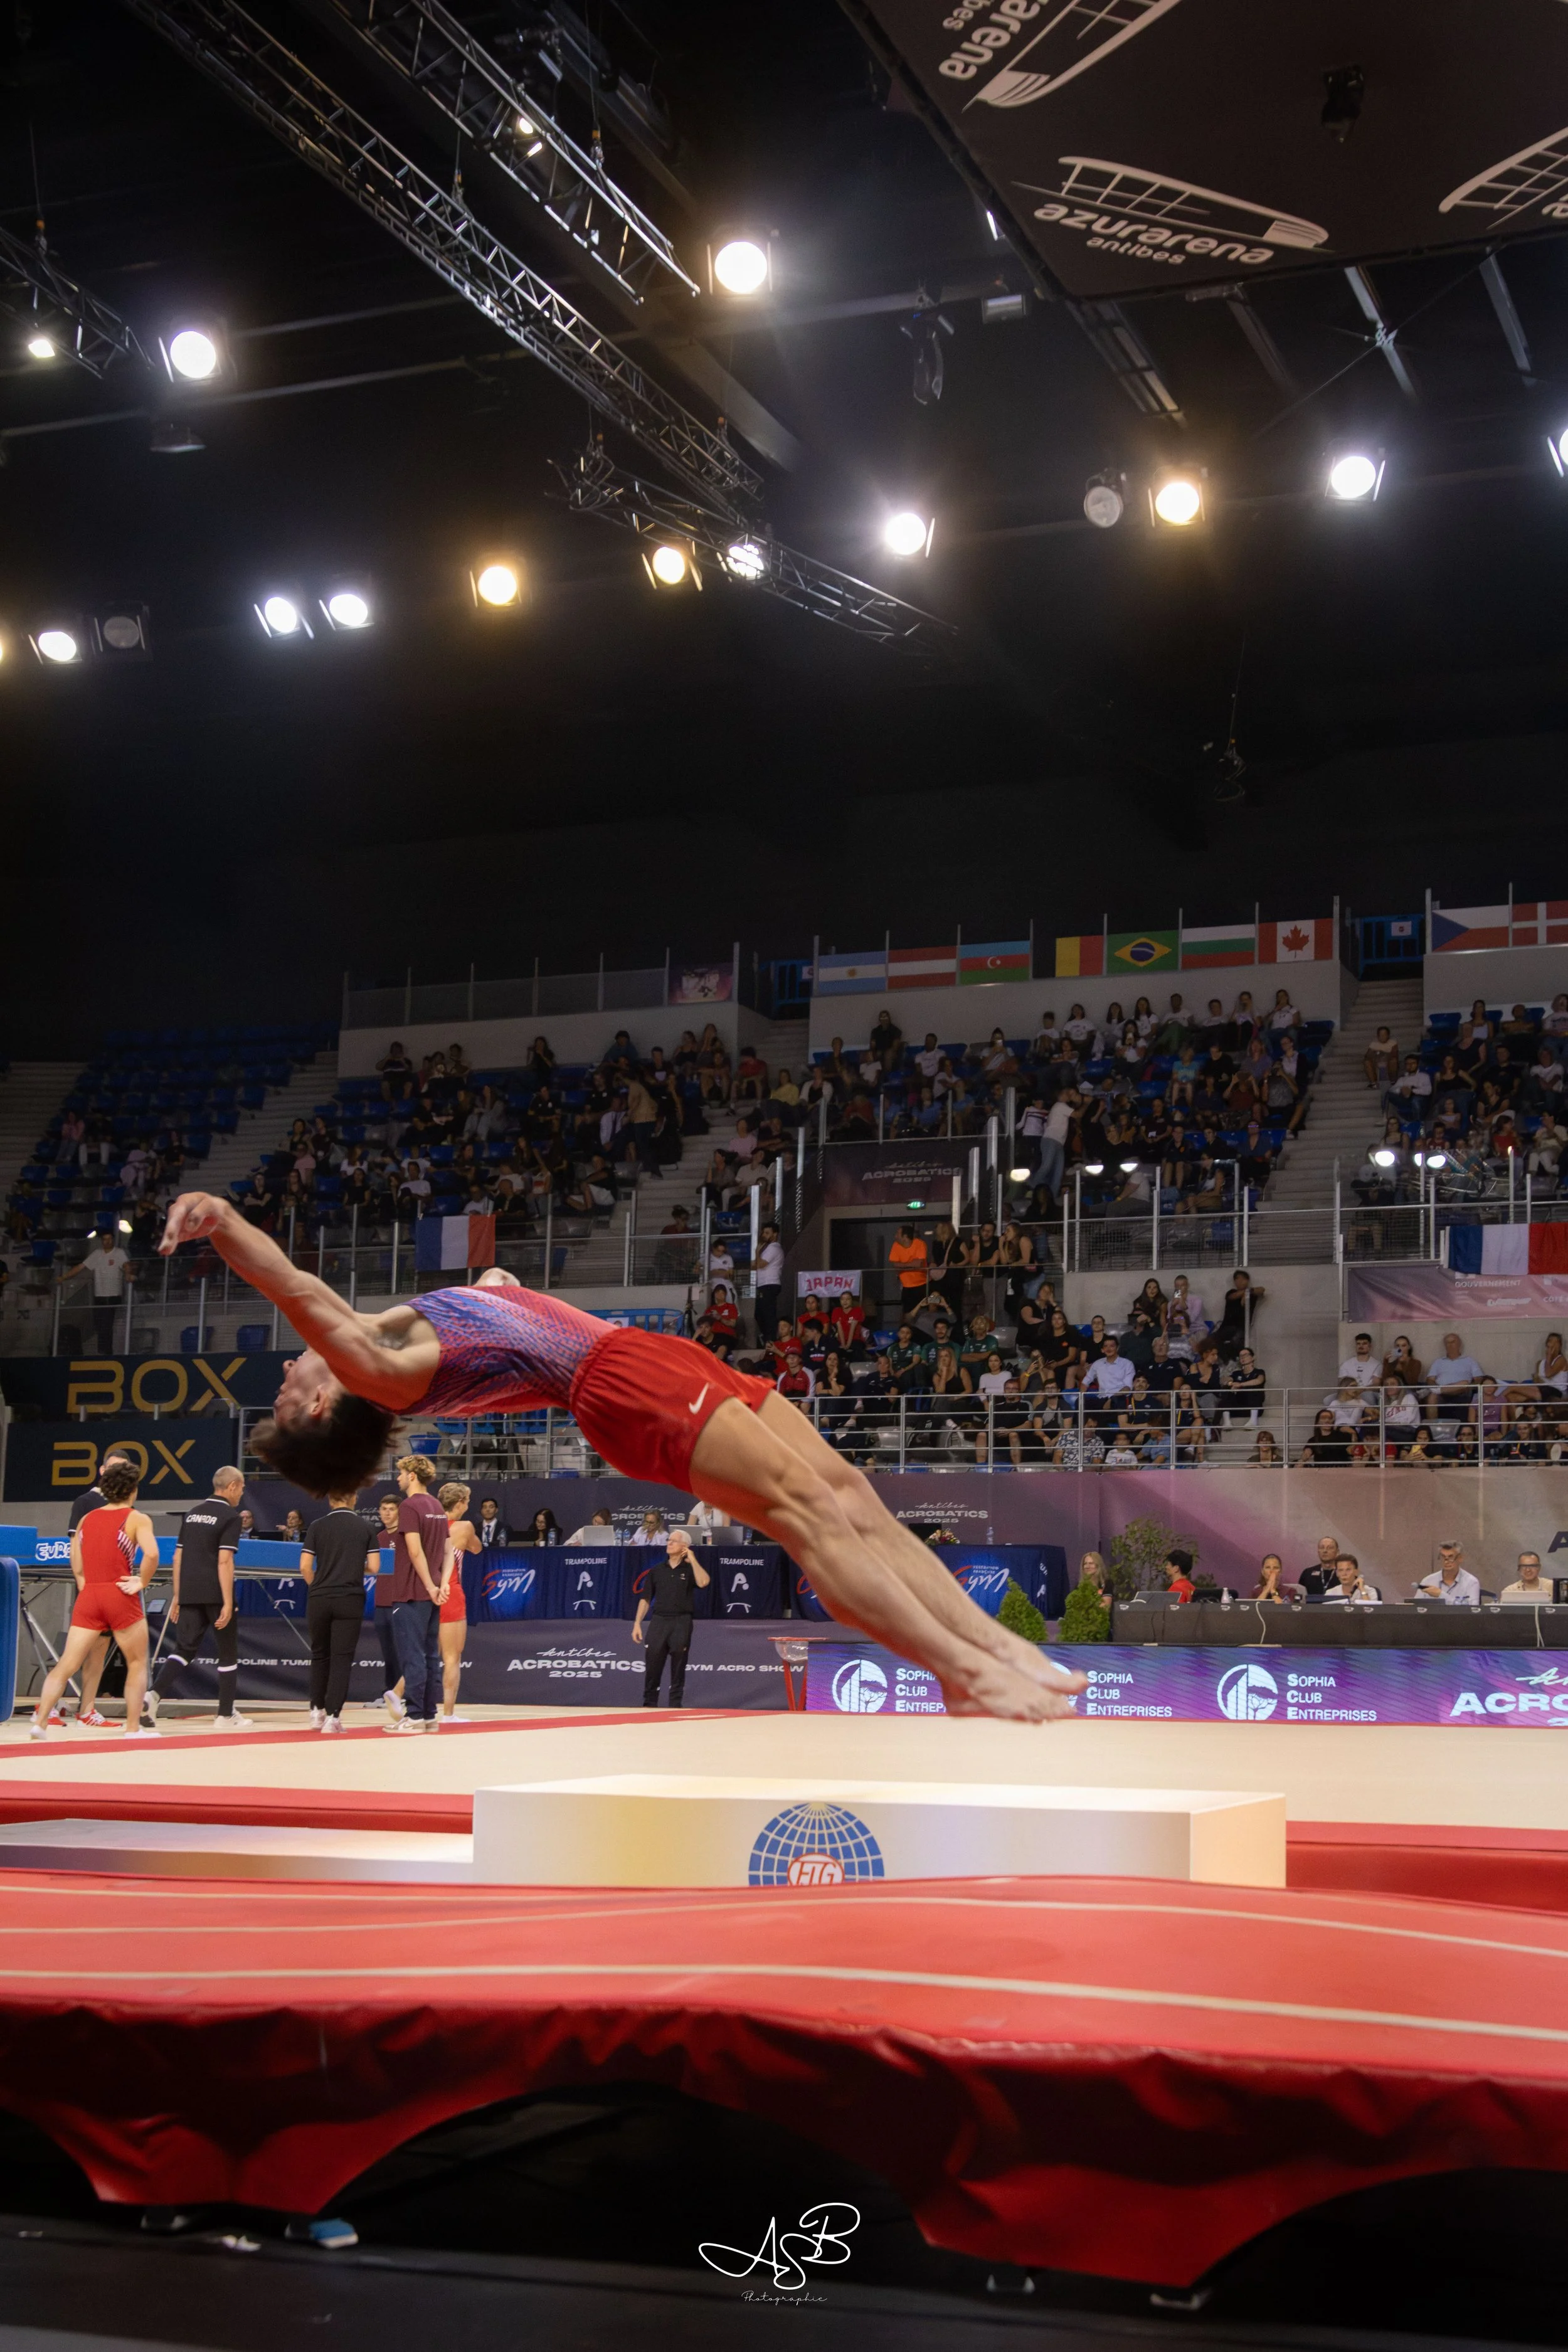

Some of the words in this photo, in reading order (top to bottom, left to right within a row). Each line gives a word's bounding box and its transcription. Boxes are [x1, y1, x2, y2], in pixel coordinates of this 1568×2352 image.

[939, 0, 1049, 80] arena
[1034, 203, 1274, 264] azurarena
[1086, 237, 1187, 265] antibes
[805, 1276, 854, 1291] JAPAN
[67, 1357, 247, 1414] BOX
[51, 1439, 196, 1485] BOX
[186, 1514, 218, 1525] CANADA
[896, 1510, 988, 1518] ACROBATICS
[719, 1557, 765, 1566] TRAMPOLINE
[537, 1648, 617, 1657] Antibes
[507, 1660, 646, 1673] ACROBATICS
[1086, 1671, 1134, 1684] SOPHIA
[1287, 1673, 1336, 1687] SOPHIA
[895, 1684, 928, 1697] CLUB
[1086, 1687, 1120, 1700] CLUB
[1287, 1690, 1322, 1703] CLUB
[1086, 1703, 1172, 1717] ENTREPRISES
[1287, 1706, 1377, 1722] ENTREPRISES
